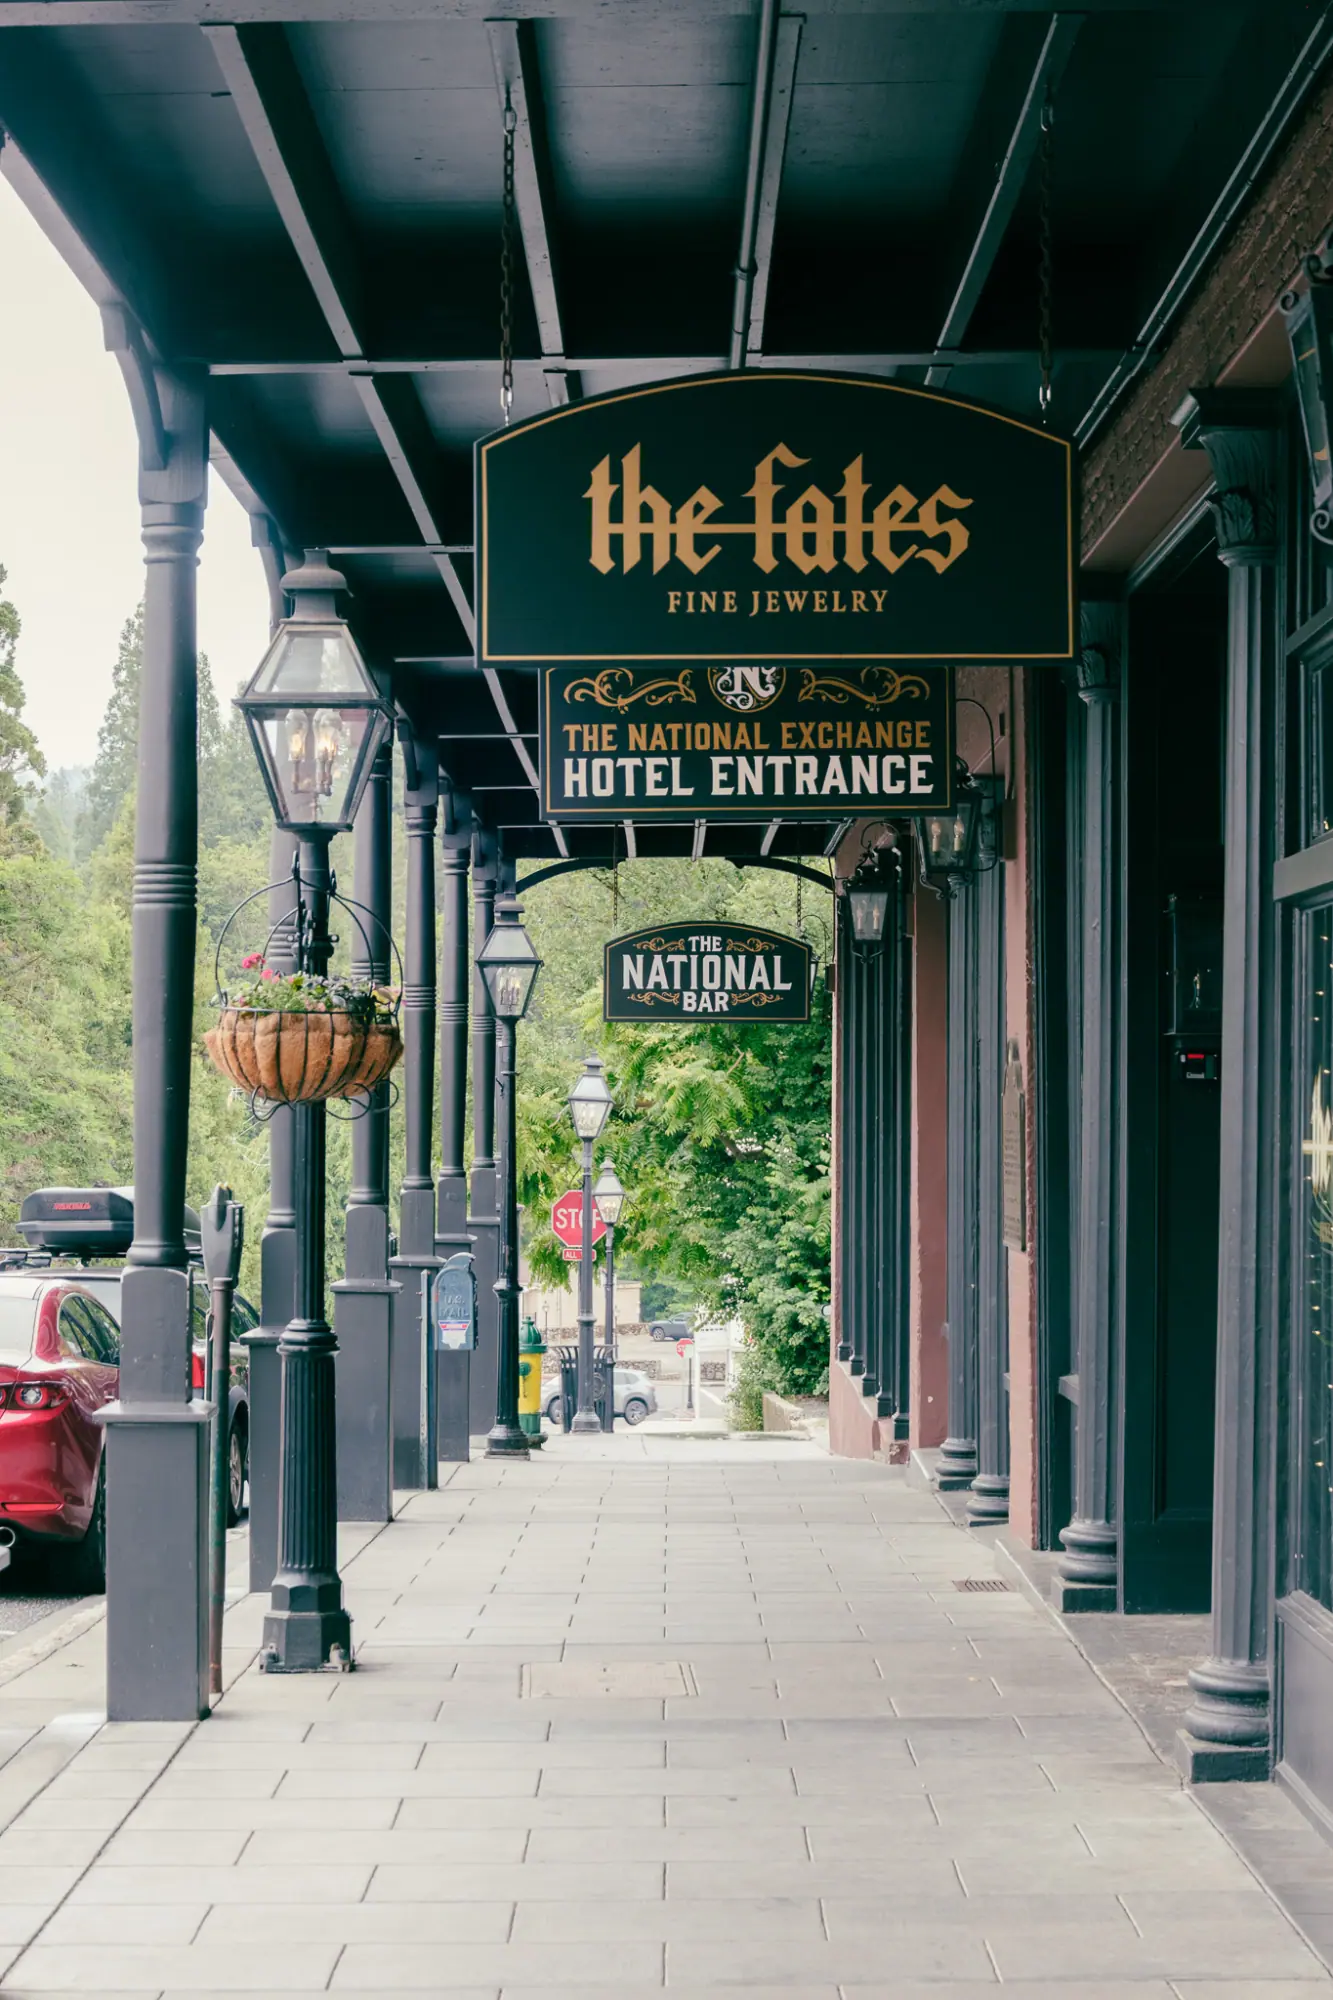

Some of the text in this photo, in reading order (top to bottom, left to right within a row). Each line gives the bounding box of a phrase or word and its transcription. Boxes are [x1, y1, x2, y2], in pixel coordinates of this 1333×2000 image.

[583, 442, 974, 575] the fates
[668, 590, 889, 617] FINE JEWELRY
[562, 721, 932, 752] THE NATIONAL EXCHANGE
[563, 754, 934, 798] HOTEL ENTRANCE
[688, 935, 723, 952] THE
[622, 954, 792, 990] NATIONAL
[682, 991, 729, 1013] BAR
[565, 1251, 577, 1259] ALL
